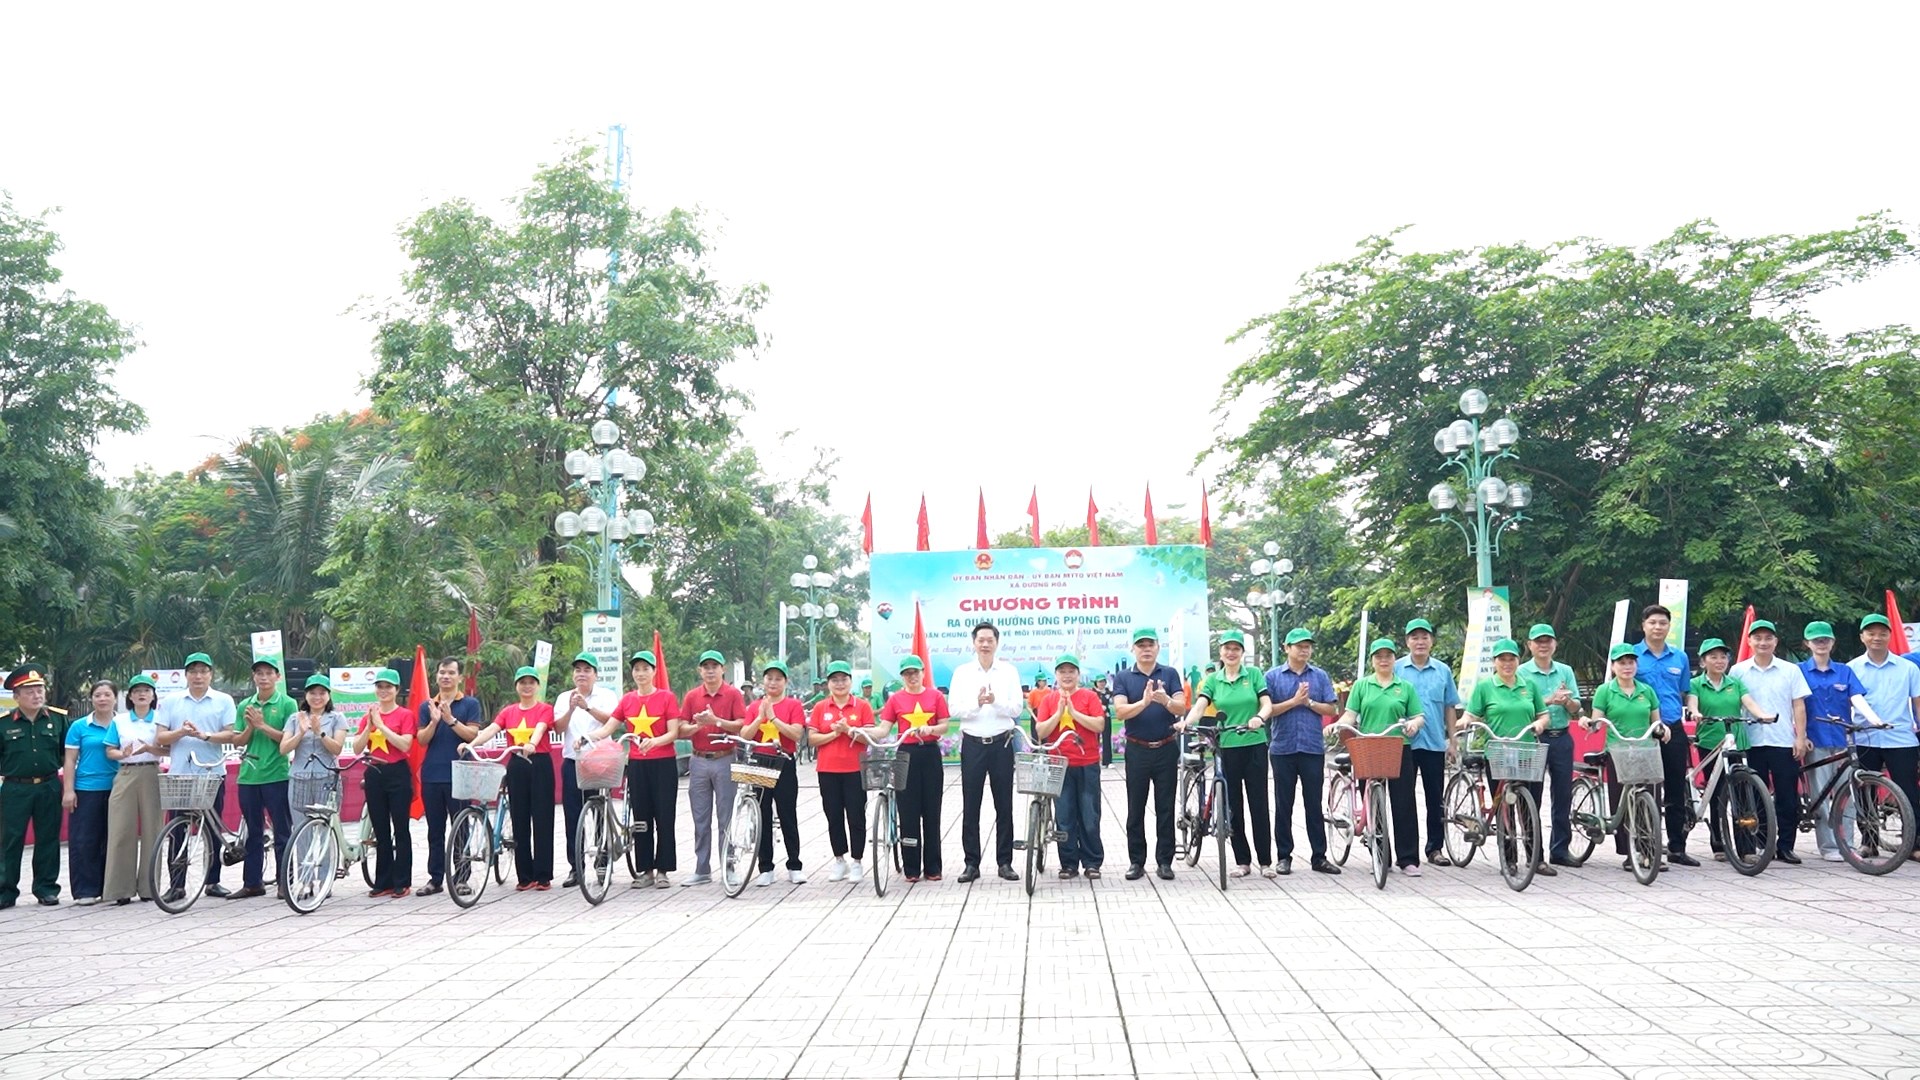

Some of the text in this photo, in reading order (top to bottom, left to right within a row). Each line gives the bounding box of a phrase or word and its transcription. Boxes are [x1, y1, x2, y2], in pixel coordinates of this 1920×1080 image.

[959, 594, 1119, 612] CHƯƠNG TRÌNH
[947, 618, 960, 628] RA
[965, 616, 994, 628] QUÂN
[1064, 616, 1100, 625] PHONG
[1104, 613, 1132, 624] TRÀO
